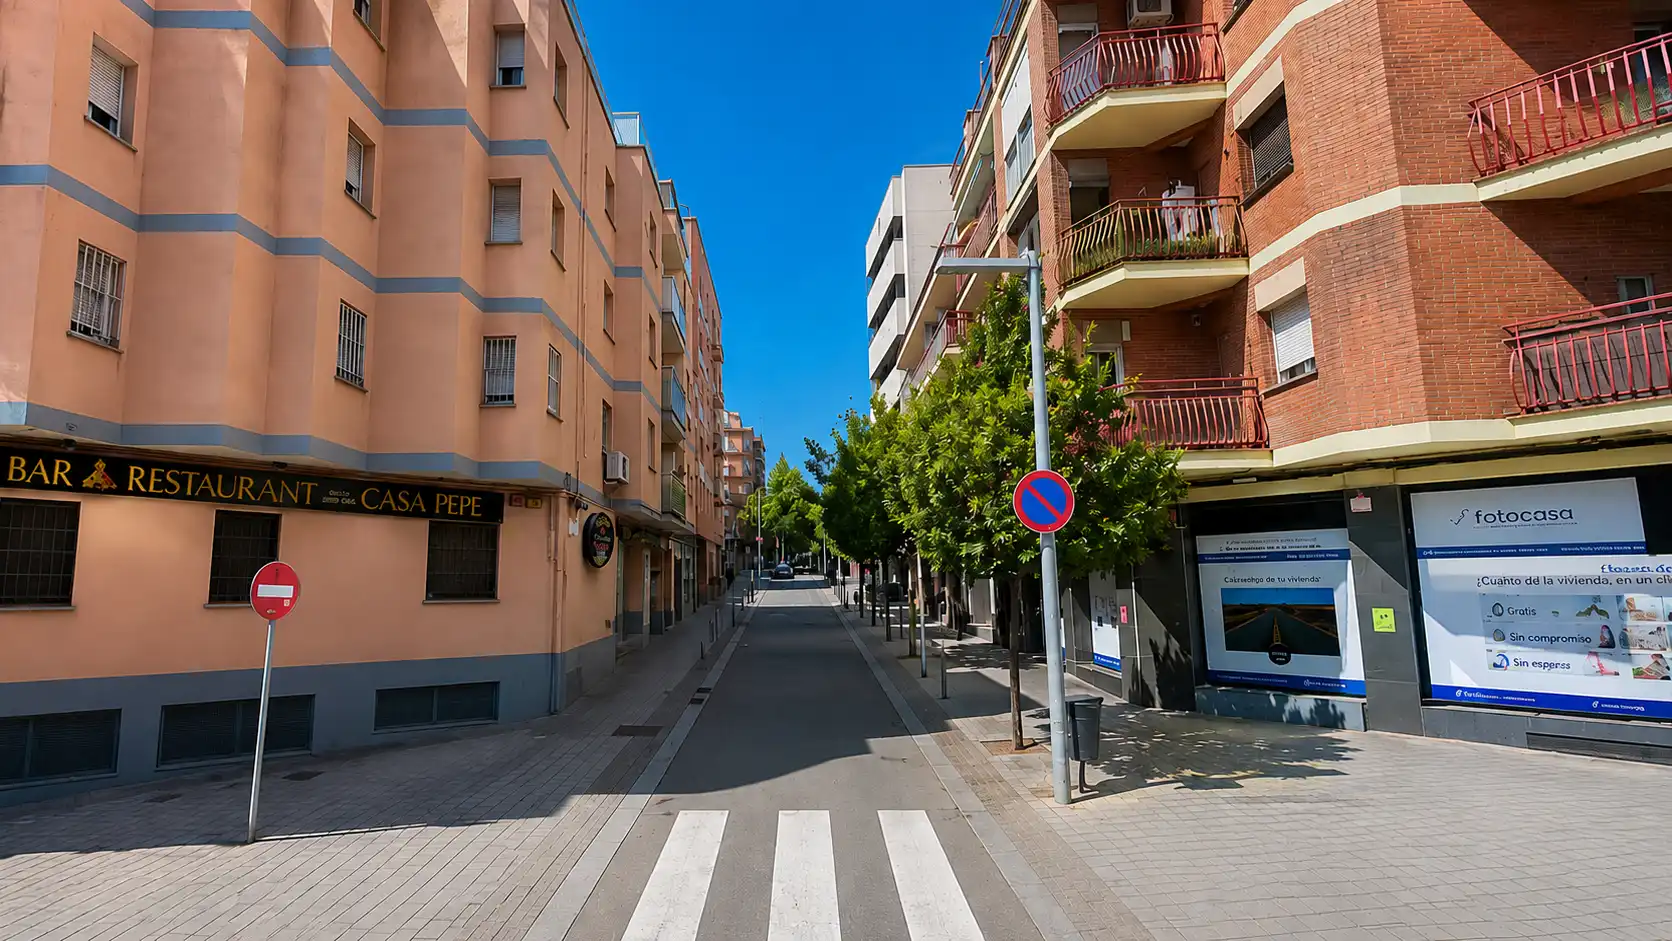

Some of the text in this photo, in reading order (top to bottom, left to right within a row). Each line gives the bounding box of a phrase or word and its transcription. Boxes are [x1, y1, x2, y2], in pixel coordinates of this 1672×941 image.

[7, 456, 482, 517] BAR RESTAURANT CASA PEPE
[1475, 508, 1574, 524] fotocasa
[1543, 576, 1554, 585] la
[1616, 577, 1632, 585] en
[1636, 577, 1653, 585] un
[1507, 606, 1537, 616] Gratis
[1509, 632, 1592, 644] Sin compromiso
[1513, 658, 1529, 667] Sin
